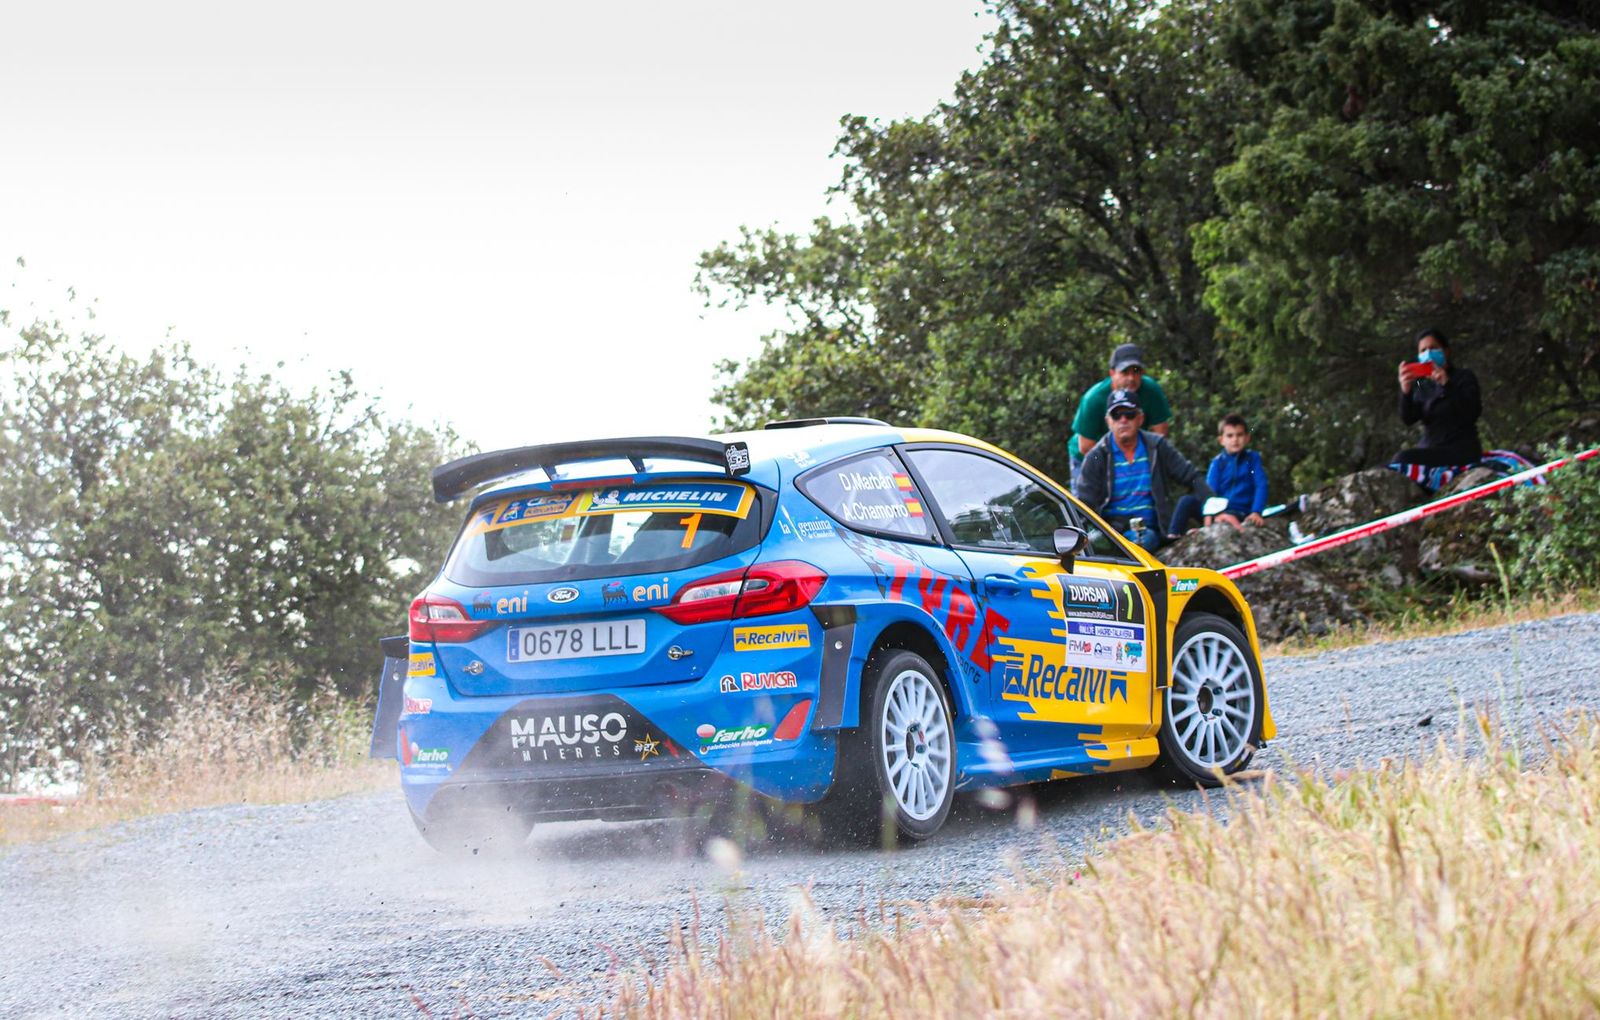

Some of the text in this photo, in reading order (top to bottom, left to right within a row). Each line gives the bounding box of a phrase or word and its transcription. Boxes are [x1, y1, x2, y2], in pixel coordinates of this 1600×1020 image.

[623, 490, 728, 502] MICHELIN
[842, 502, 909, 521] A.Chamorro
[680, 512, 703, 549] 1
[798, 516, 832, 537] genuina
[553, 589, 572, 601] Ford
[632, 577, 669, 603] eni
[1069, 585, 1109, 603] DURSAN
[496, 590, 529, 615] eni
[1122, 584, 1134, 620] 1
[876, 551, 1011, 673] TYRE
[524, 625, 638, 657] 0678 LLL
[748, 630, 796, 645] Recalvi
[741, 671, 797, 690] RUVICSA
[1024, 653, 1108, 704] Recalvi
[510, 712, 627, 748] MAUSO
[712, 725, 767, 743] farho
[417, 748, 448, 761] farho
[523, 744, 620, 762] MIERES
[634, 742, 655, 753] #27
